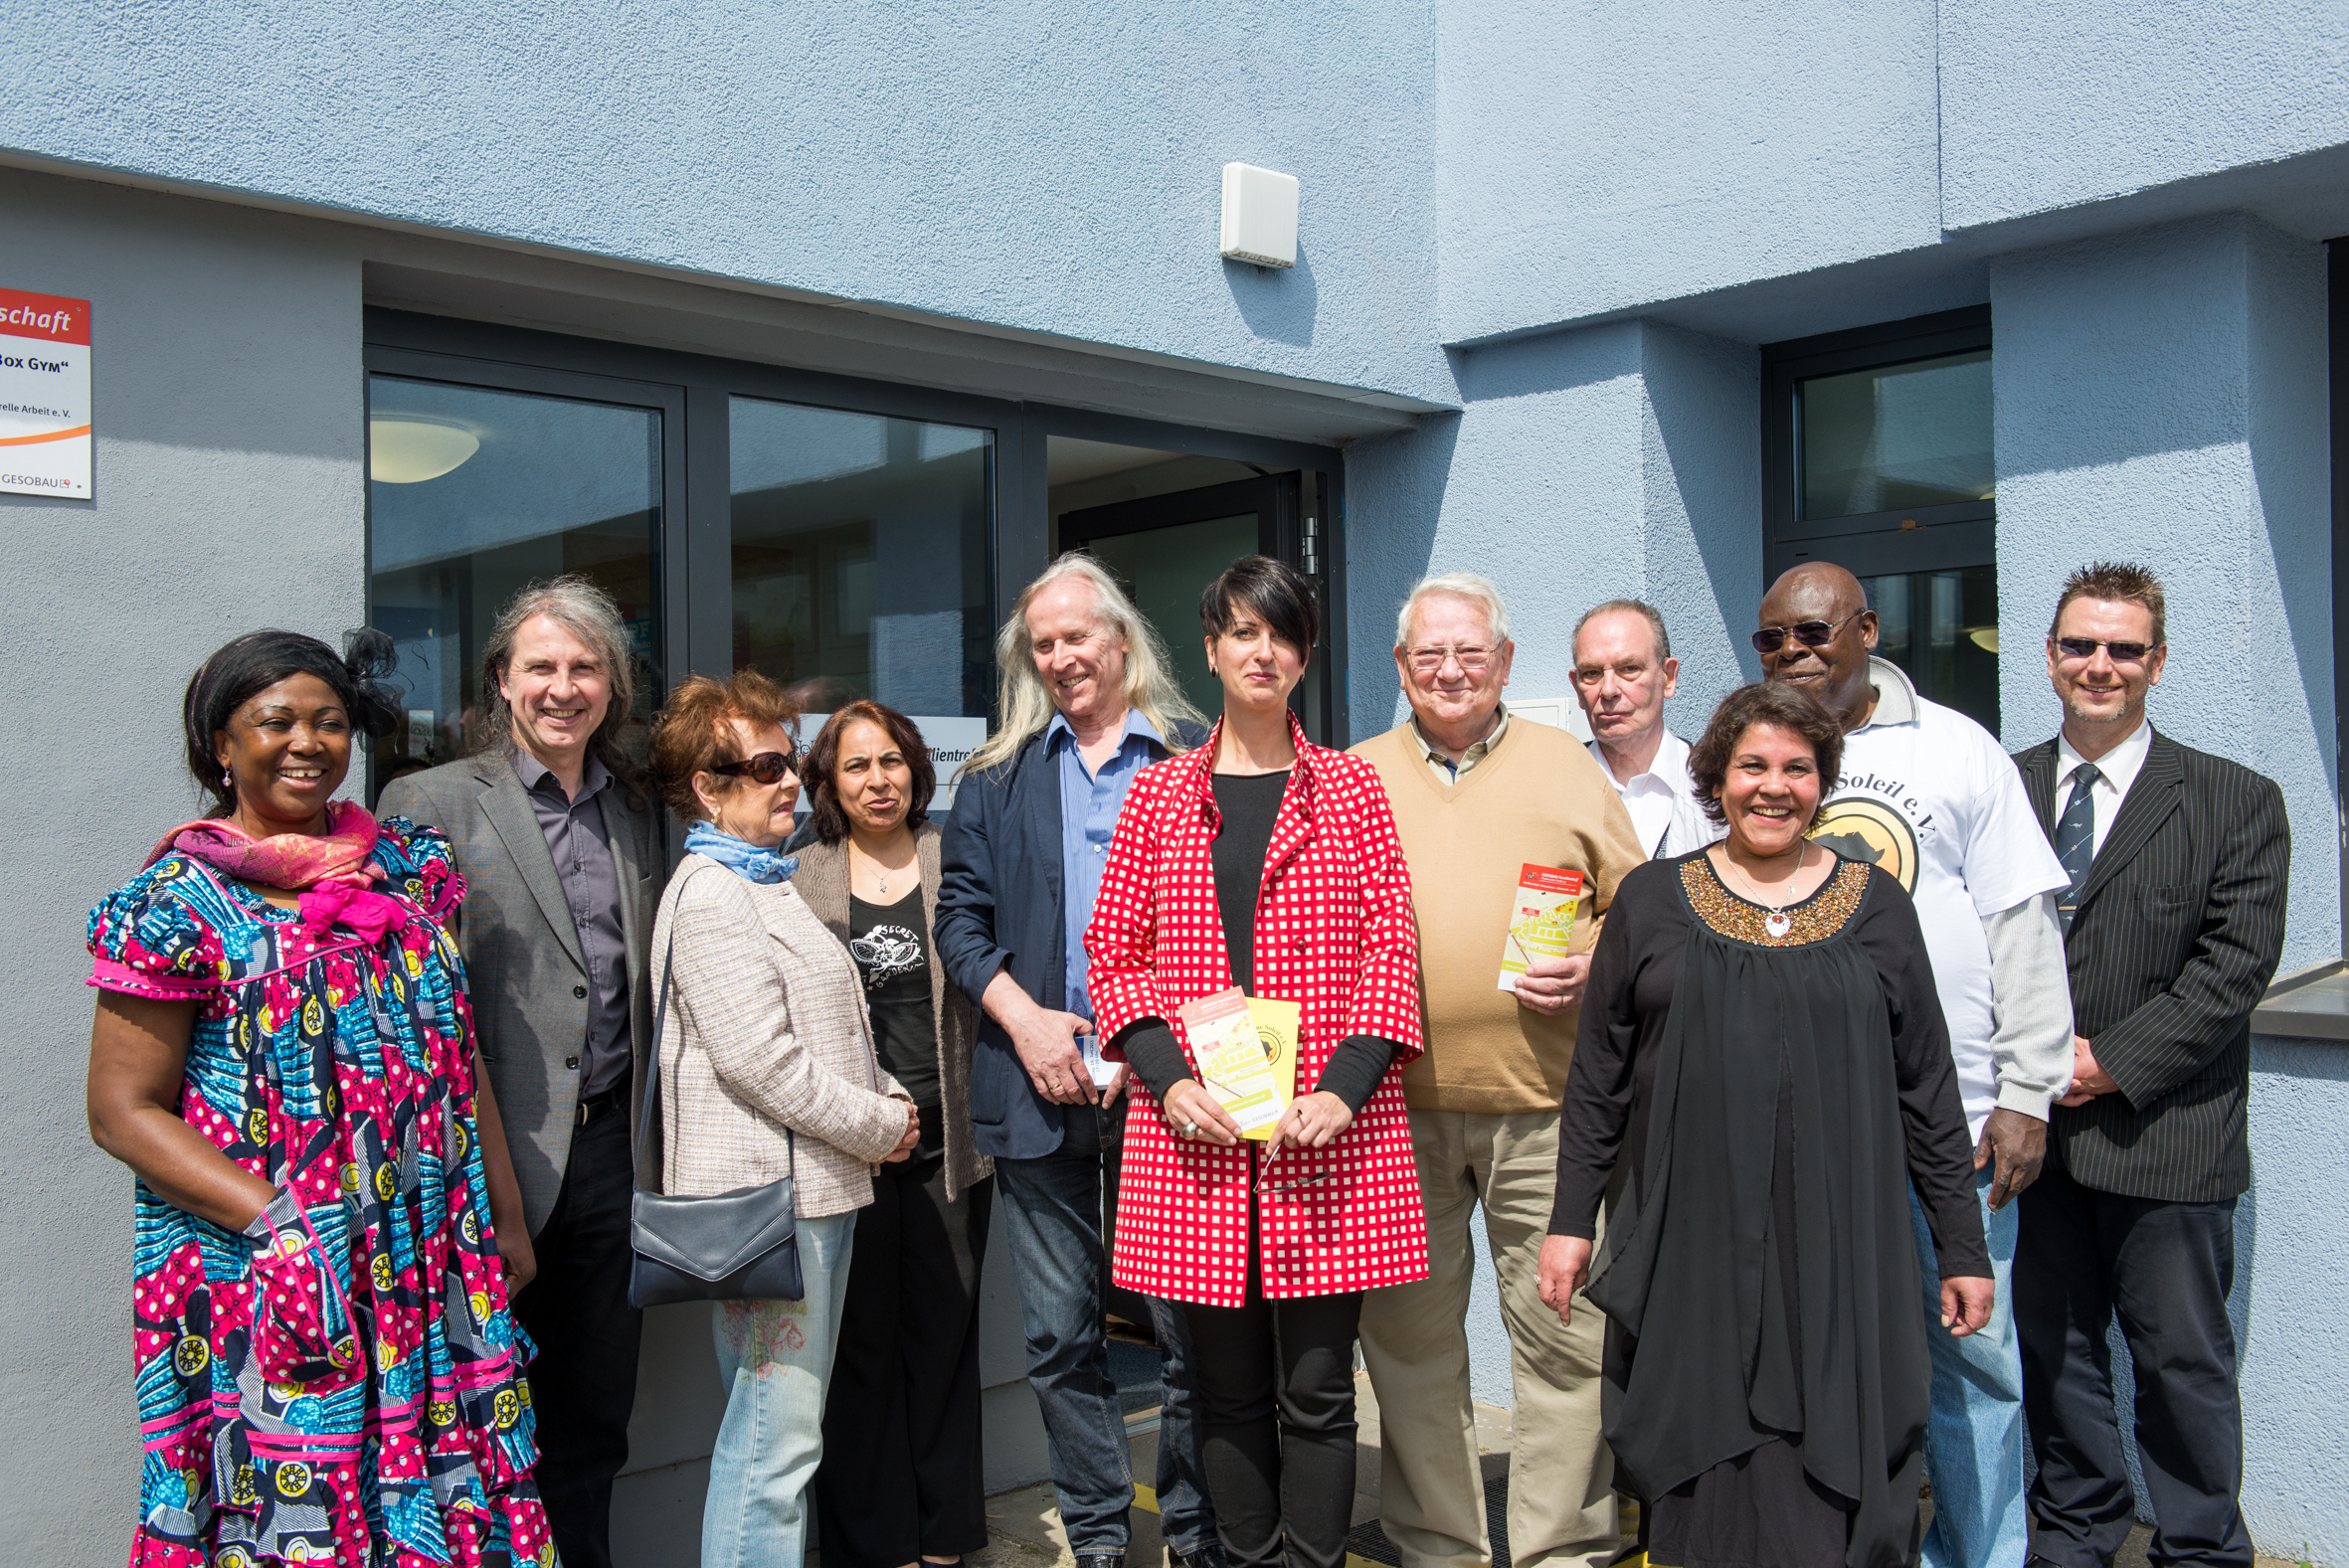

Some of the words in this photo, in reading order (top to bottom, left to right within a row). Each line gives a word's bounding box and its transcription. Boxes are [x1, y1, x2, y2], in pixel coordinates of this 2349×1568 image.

[21, 405, 50, 416] Arbeit
[1, 473, 58, 488] GESOBAU
[1838, 772, 1905, 798] Soleil
[880, 925, 919, 943] SECRET
[875, 963, 914, 988] GARDEN
